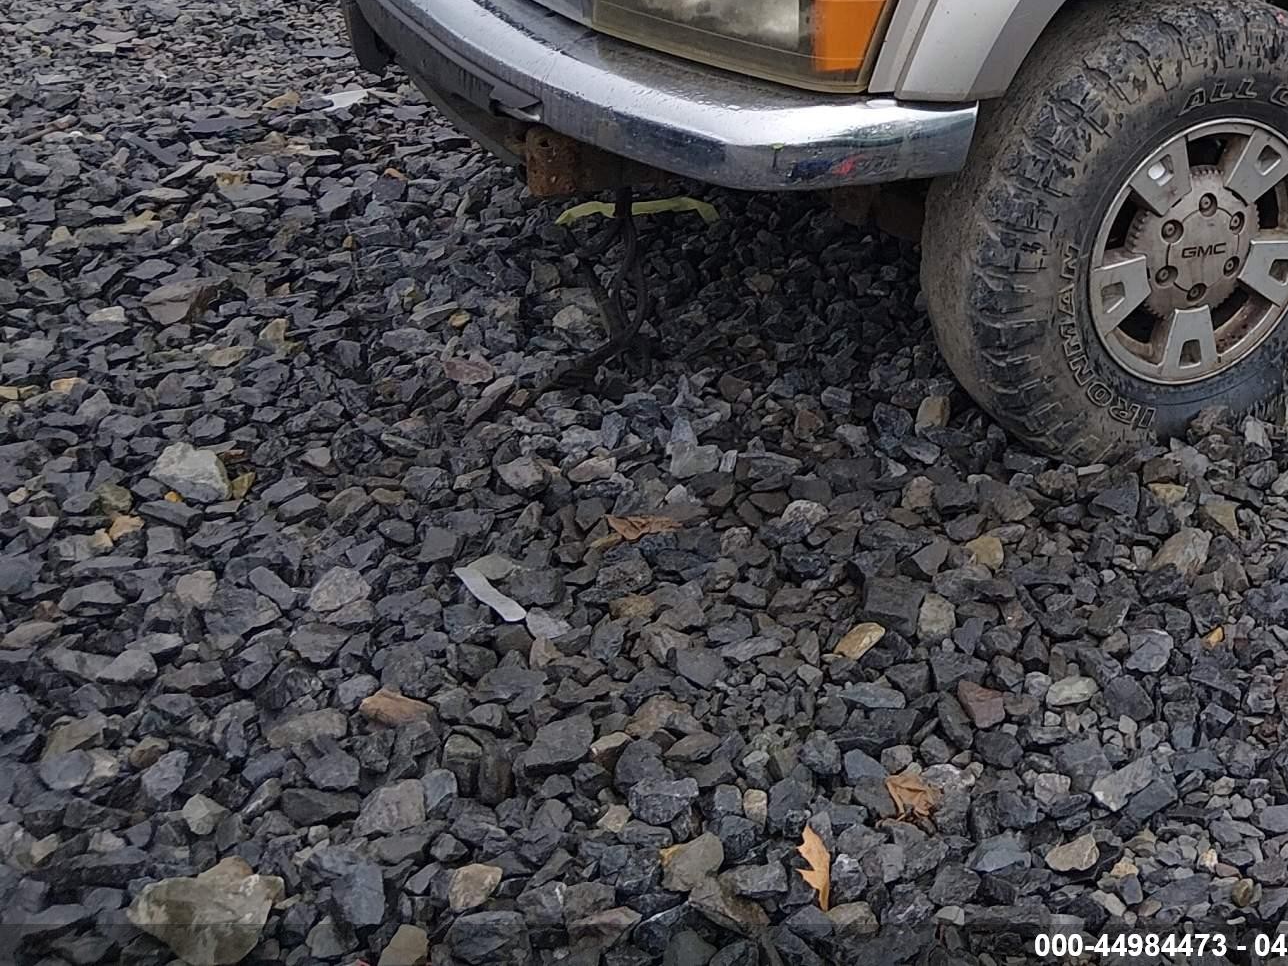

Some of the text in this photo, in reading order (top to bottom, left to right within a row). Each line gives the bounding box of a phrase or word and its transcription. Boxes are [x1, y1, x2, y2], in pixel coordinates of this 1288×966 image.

[1178, 78, 1258, 117] ALL
[1181, 242, 1227, 259] GMC
[1059, 244, 1156, 429] IRONMAN
